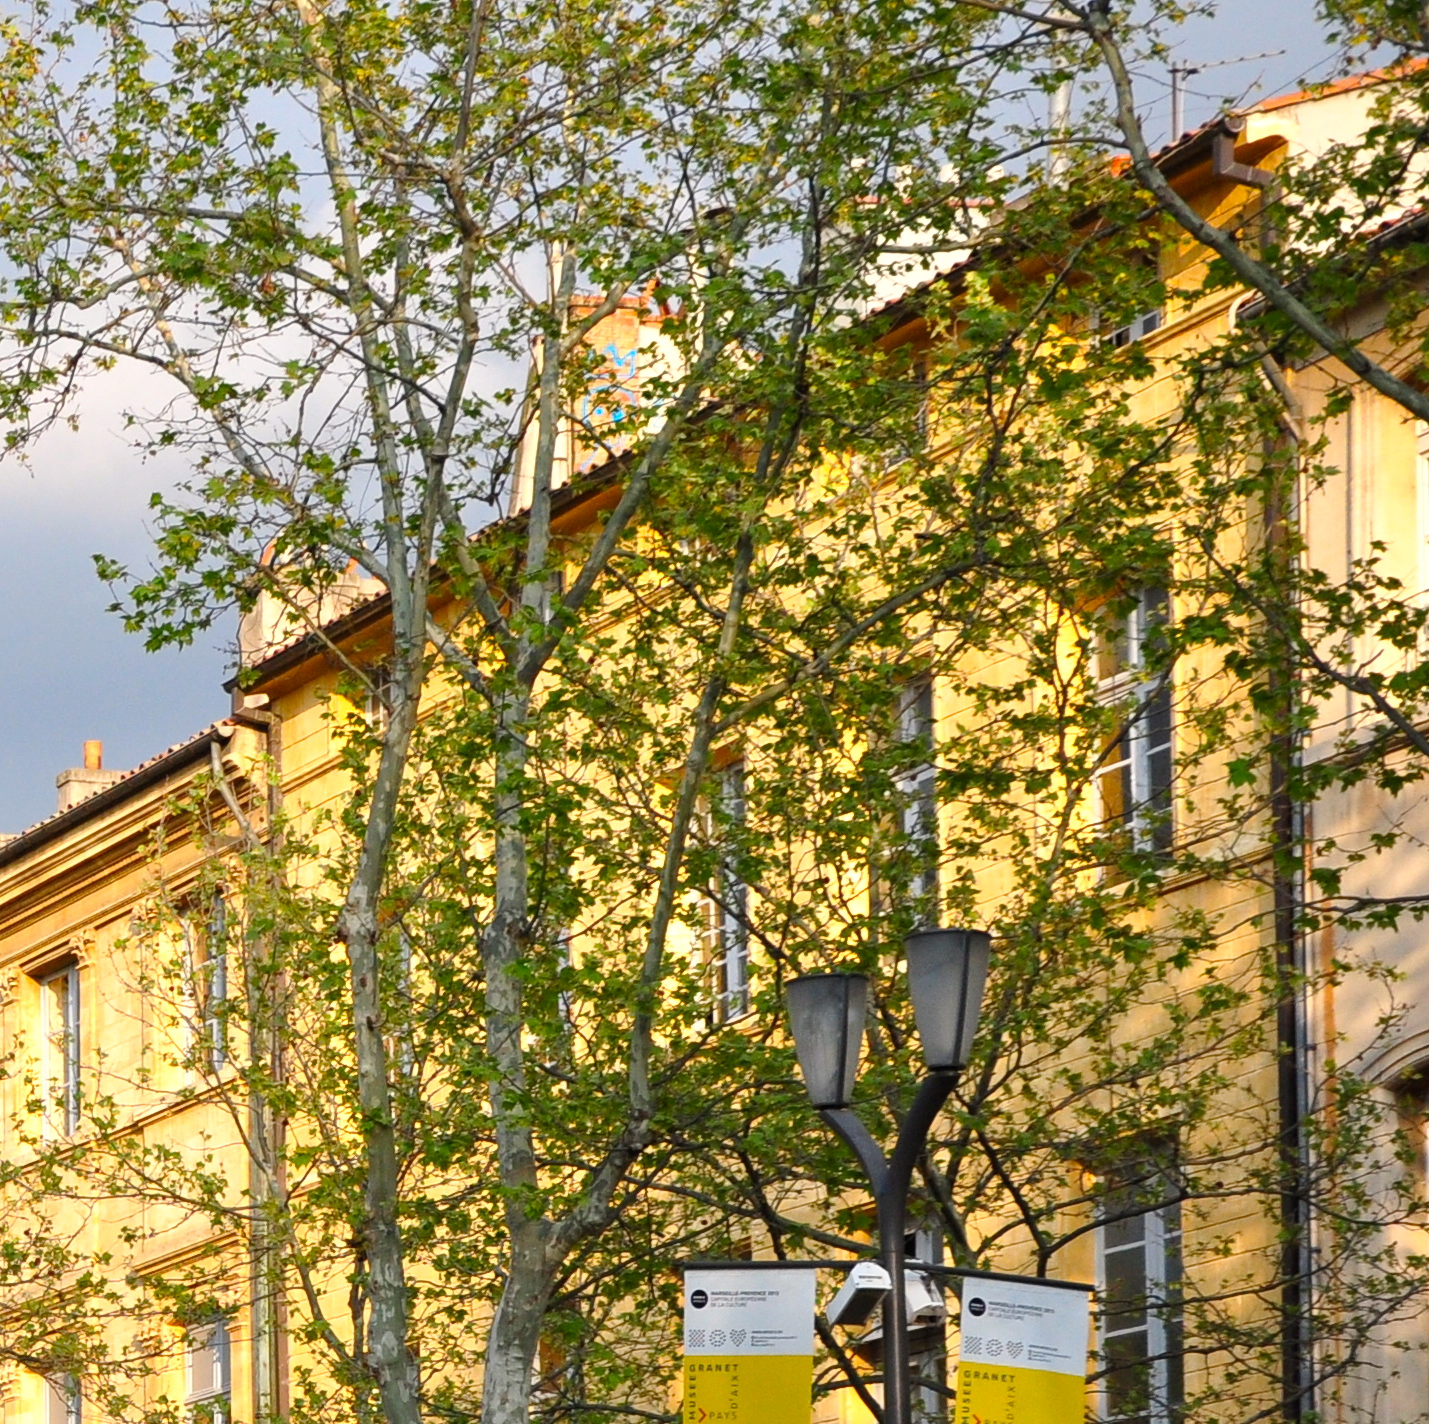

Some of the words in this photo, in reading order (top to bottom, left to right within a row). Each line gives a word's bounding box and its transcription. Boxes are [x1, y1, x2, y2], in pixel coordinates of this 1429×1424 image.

[689, 1364, 738, 1372] GRANET
[964, 1370, 1015, 1383] GRANET
[689, 1375, 697, 1420] MUSEE
[731, 1375, 739, 1409] D'AIX
[1005, 1386, 1016, 1420] D'AIX
[709, 1412, 737, 1420] PAYS
